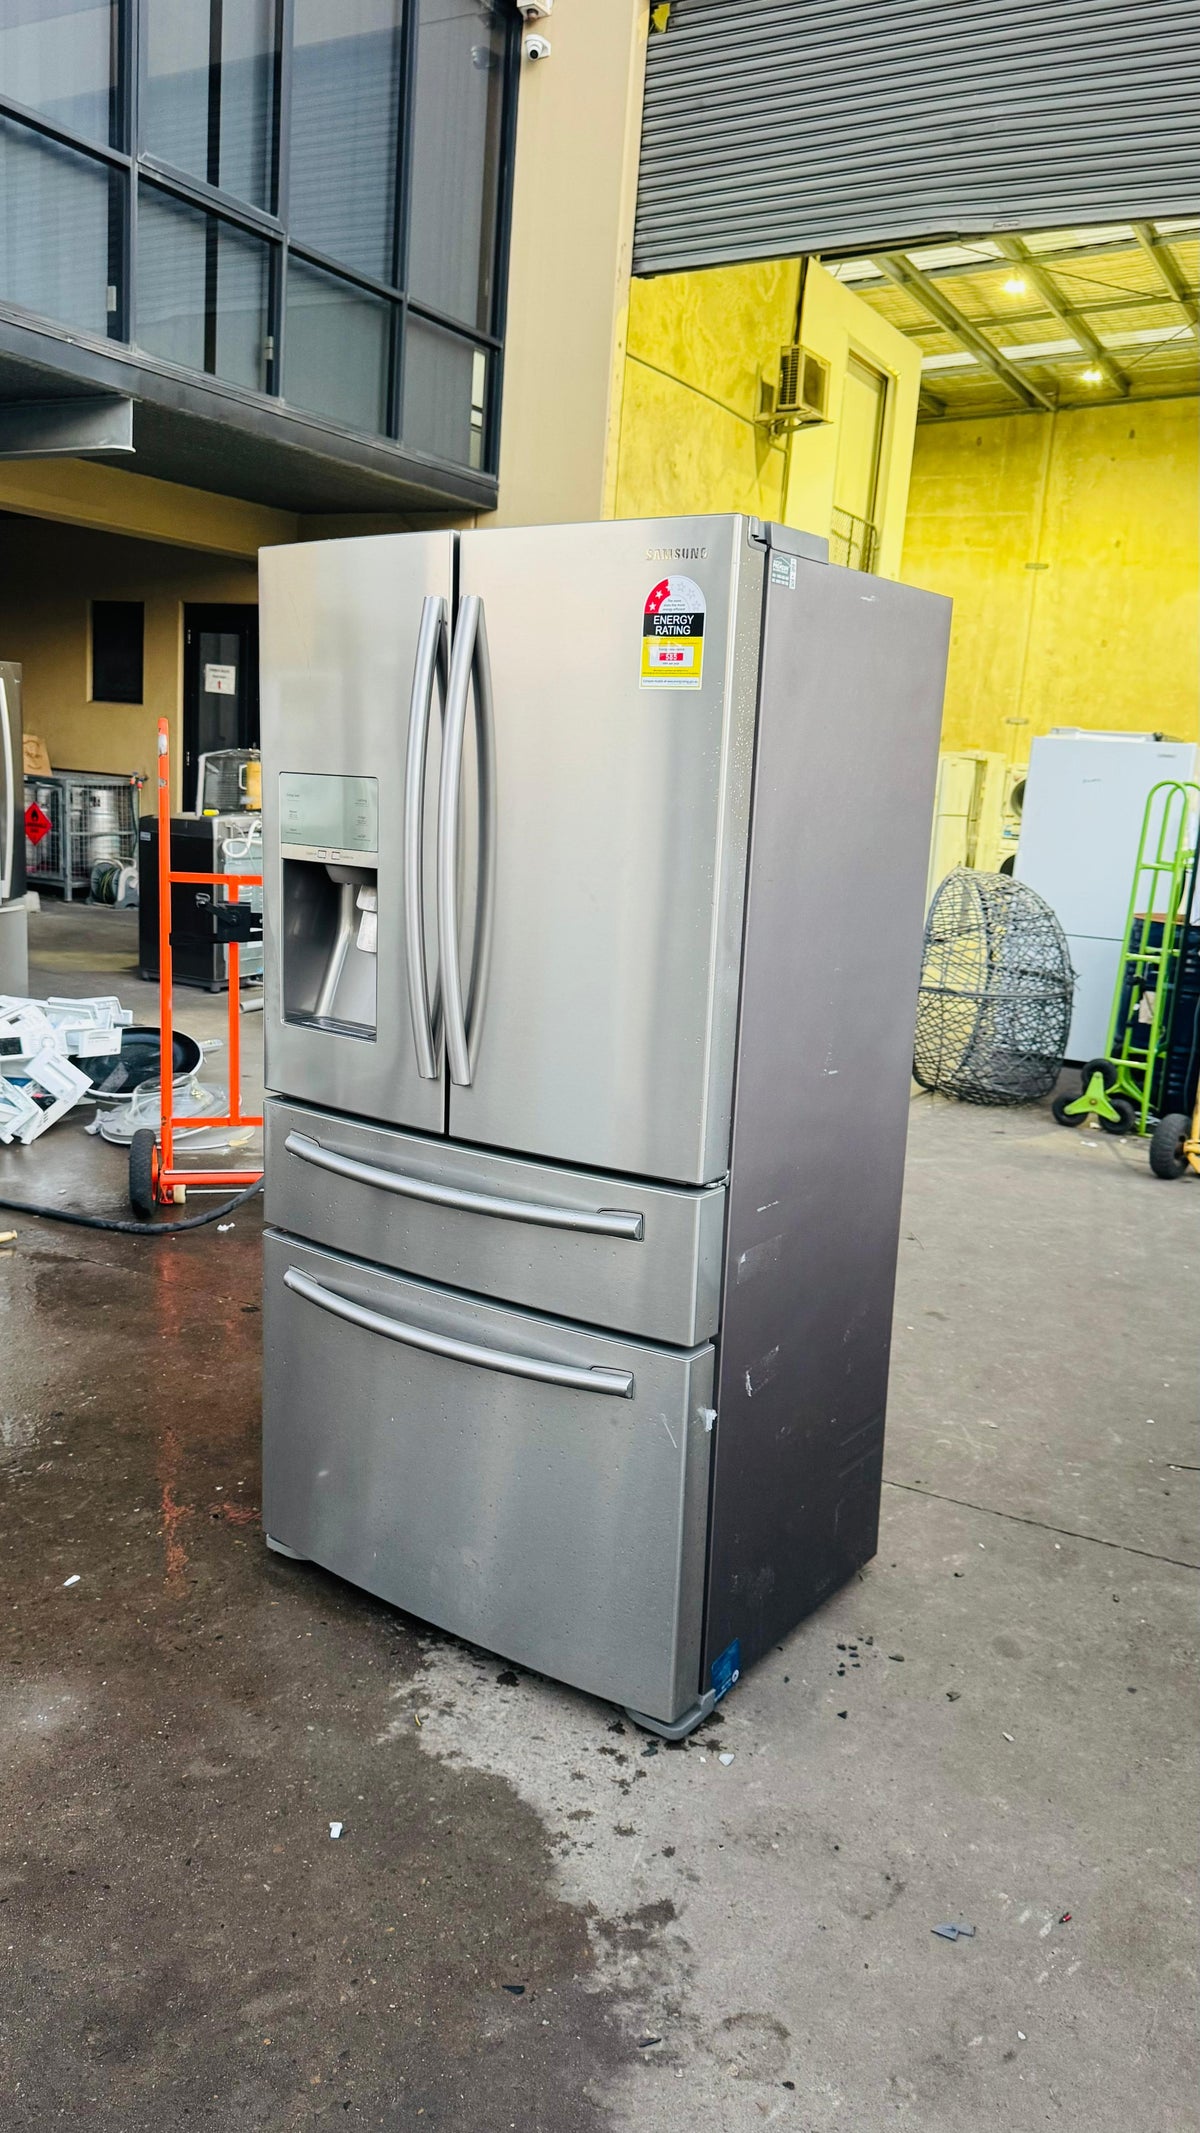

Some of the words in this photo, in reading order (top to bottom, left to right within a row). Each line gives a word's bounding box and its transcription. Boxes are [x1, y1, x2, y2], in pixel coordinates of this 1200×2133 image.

[646, 547, 709, 561] SAMSUNG
[653, 615, 695, 625] ENERGY
[655, 625, 691, 635] RATING
